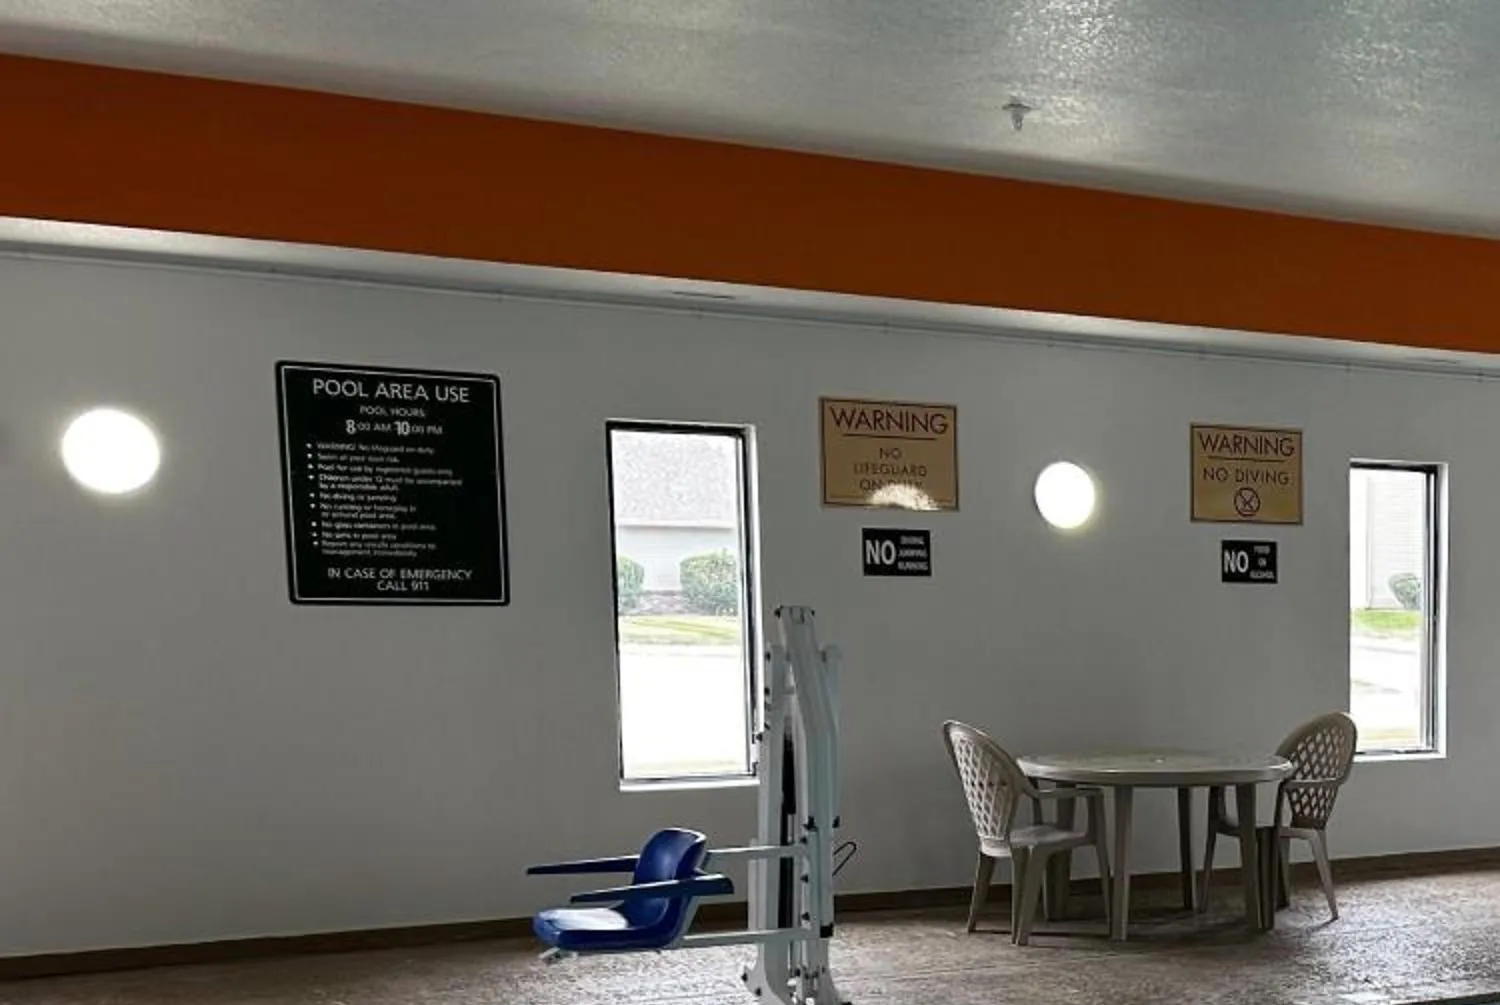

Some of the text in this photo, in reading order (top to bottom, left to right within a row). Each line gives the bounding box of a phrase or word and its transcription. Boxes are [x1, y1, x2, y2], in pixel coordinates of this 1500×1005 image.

[313, 379, 471, 403] POOL AREA USE
[360, 405, 388, 416] POOL
[373, 422, 391, 431] AM
[426, 425, 443, 434] PM
[829, 406, 949, 435] WARNING
[1197, 432, 1295, 457] WARNING
[879, 447, 902, 460] NO
[854, 463, 928, 477] LIFEGUARD
[1202, 467, 1289, 485] NO DIVING
[865, 539, 896, 565] NO
[1223, 550, 1249, 573] NO
[328, 567, 472, 580] IN CASE OF EMERGENCY
[377, 580, 429, 592] CALL 911
